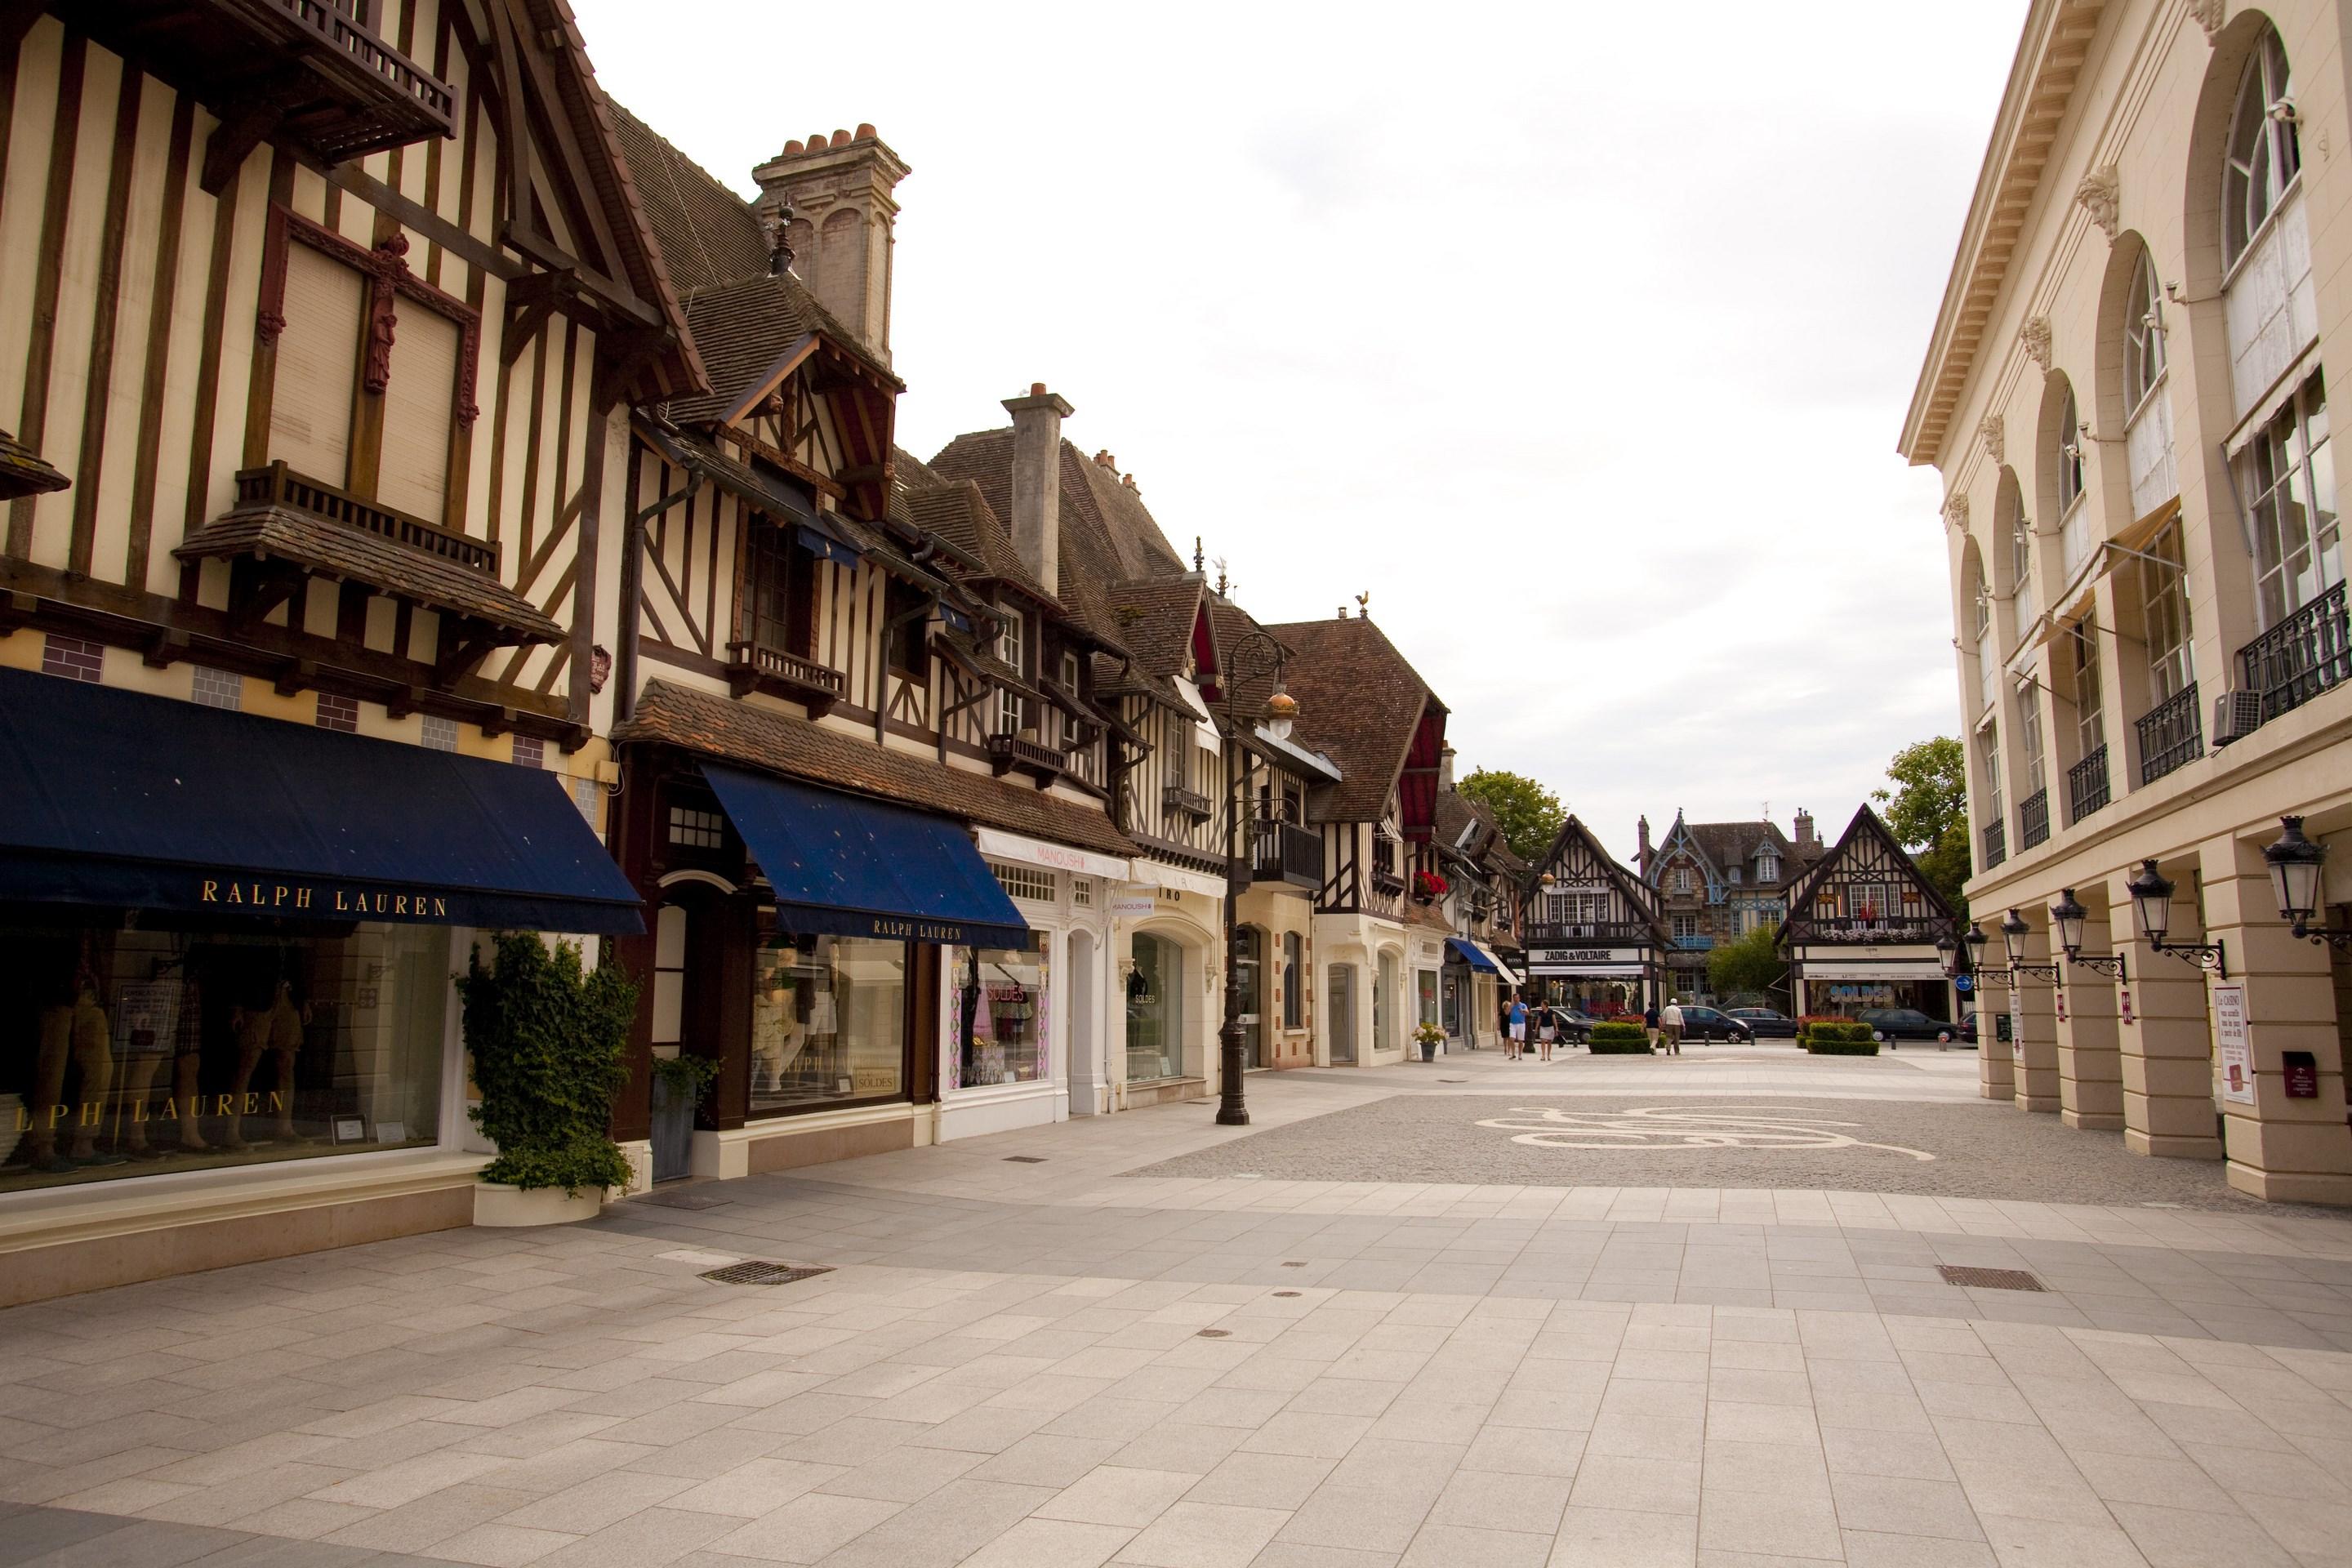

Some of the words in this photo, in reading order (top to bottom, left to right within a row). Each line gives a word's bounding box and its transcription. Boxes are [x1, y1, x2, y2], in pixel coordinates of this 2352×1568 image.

[1037, 848, 1080, 868] MANOUSH
[202, 880, 313, 907] RALPH
[335, 891, 446, 916] LAUREN
[1159, 887, 1180, 901] IRO
[874, 920, 911, 936] RALPH
[920, 924, 961, 940] LAUREN
[987, 985, 1024, 1001] SOLDES
[1135, 994, 1156, 1004] SOLDES
[1830, 985, 1892, 1003] SOLDES
[858, 1077, 893, 1087] SOLDES
[133, 1090, 285, 1124] LAUREN
